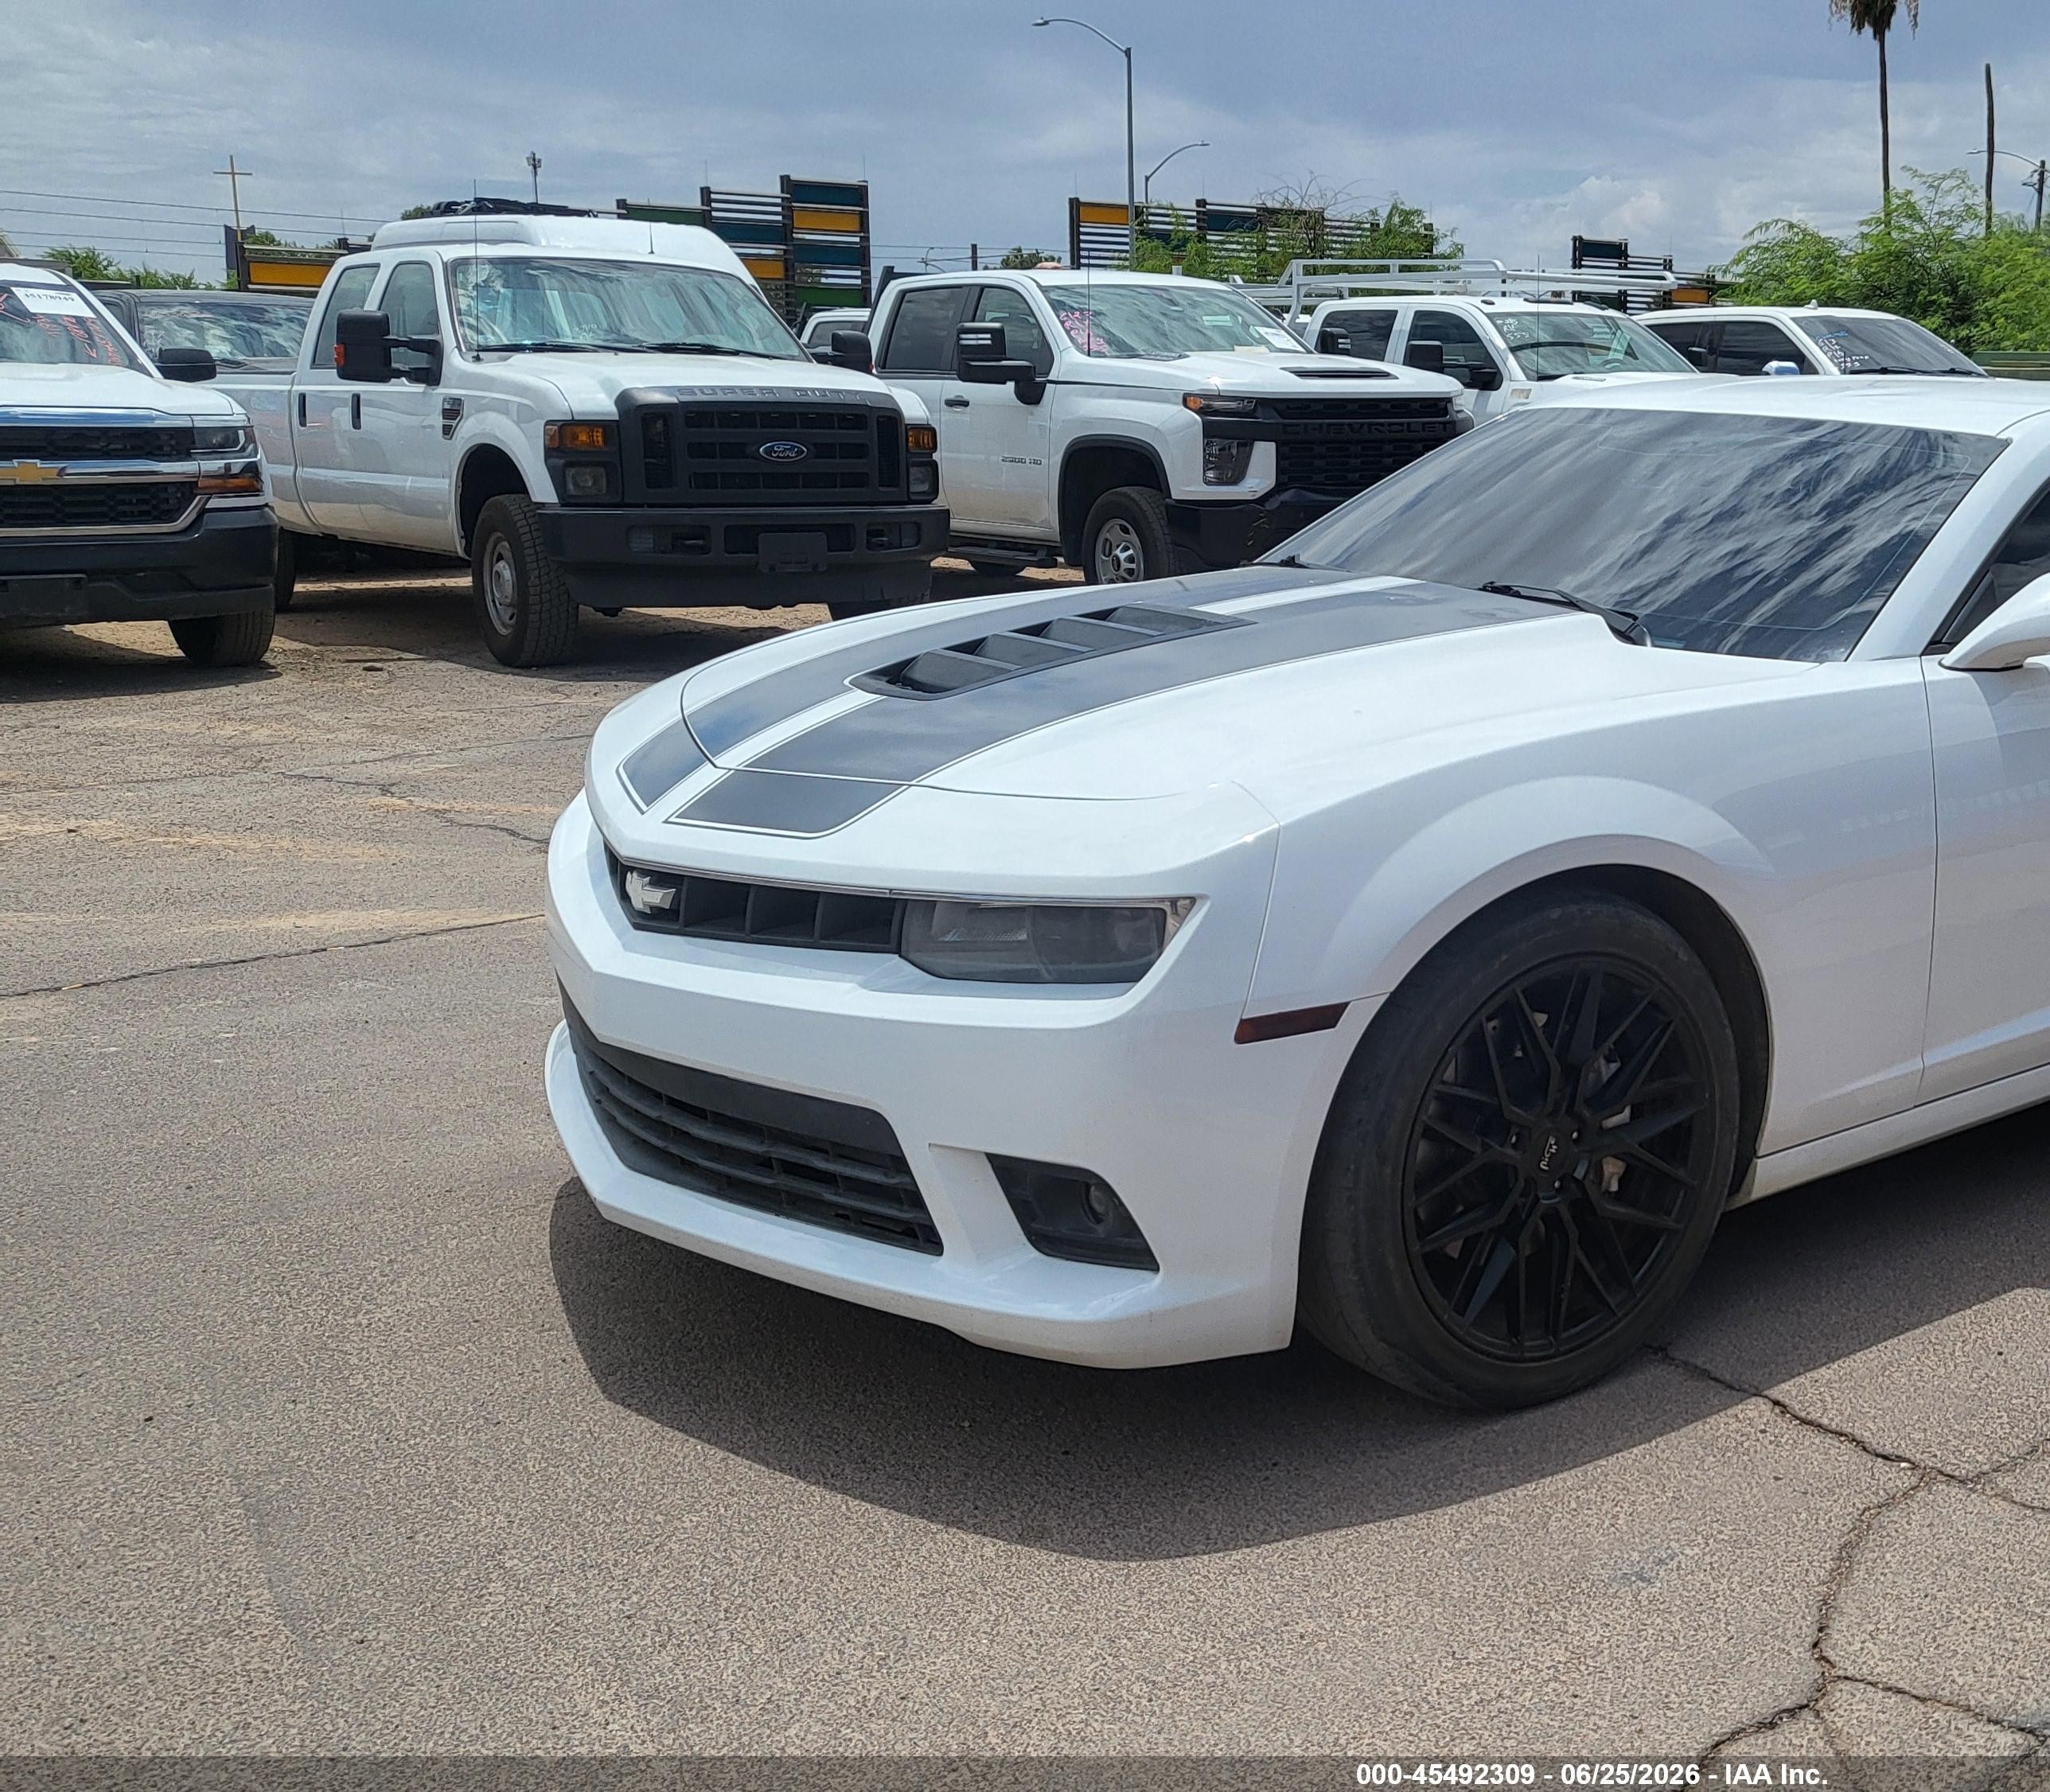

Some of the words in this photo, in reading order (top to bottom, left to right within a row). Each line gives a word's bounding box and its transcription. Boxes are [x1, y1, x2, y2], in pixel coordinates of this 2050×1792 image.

[676, 388, 779, 398] SUPER
[796, 389, 871, 404] DUTY
[1282, 421, 1457, 436] CHEVROLET
[770, 444, 799, 458] Ford
[1001, 455, 1027, 465] 2500
